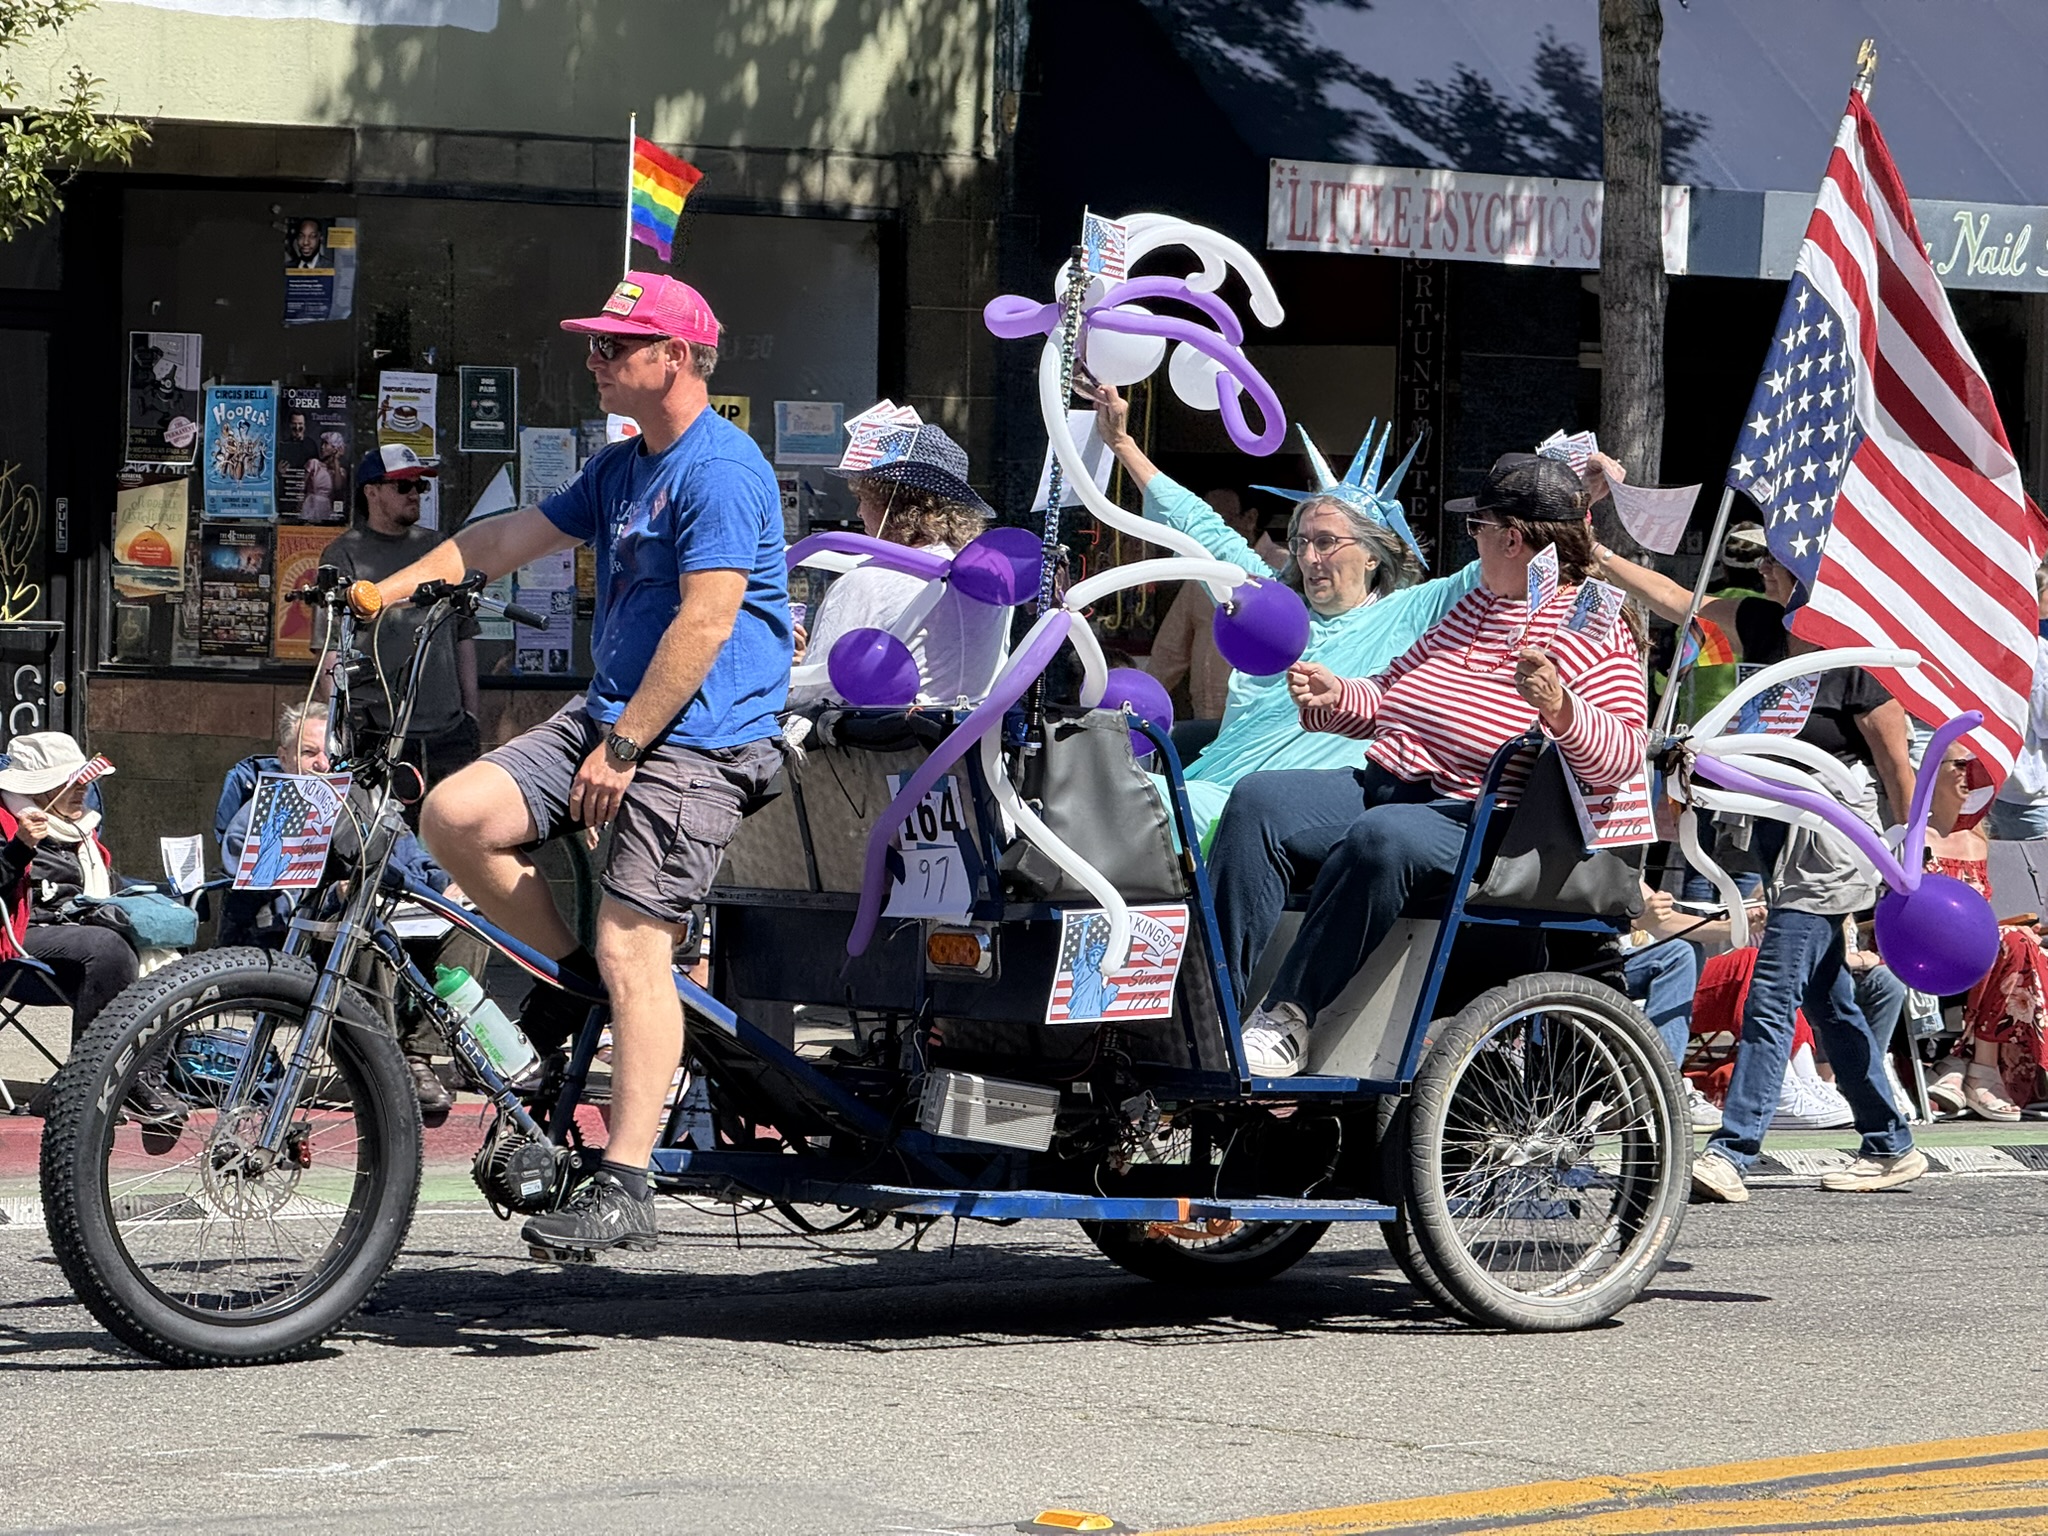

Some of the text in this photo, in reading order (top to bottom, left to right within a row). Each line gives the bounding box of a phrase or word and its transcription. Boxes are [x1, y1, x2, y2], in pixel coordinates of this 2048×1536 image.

[1286, 177, 1413, 250] LITTLE
[1420, 187, 1573, 260] PSYCHIC
[1937, 210, 2033, 278] Nail
[215, 390, 268, 400] CIRCUS BELLA
[282, 388, 321, 399] POCKET
[287, 398, 321, 409] OPERA
[327, 395, 346, 404] 2025
[872, 427, 893, 438] KINGS
[300, 780, 334, 815] NO KINGS
[1599, 796, 1638, 816] Since
[904, 785, 961, 842] 164
[1604, 819, 1645, 839] 1776
[290, 862, 319, 881] 1776
[918, 855, 950, 904] 97
[1134, 916, 1171, 948] KINGS
[1128, 969, 1162, 988] Since
[1126, 993, 1163, 1011] 1776
[96, 984, 221, 1116] KENDA
